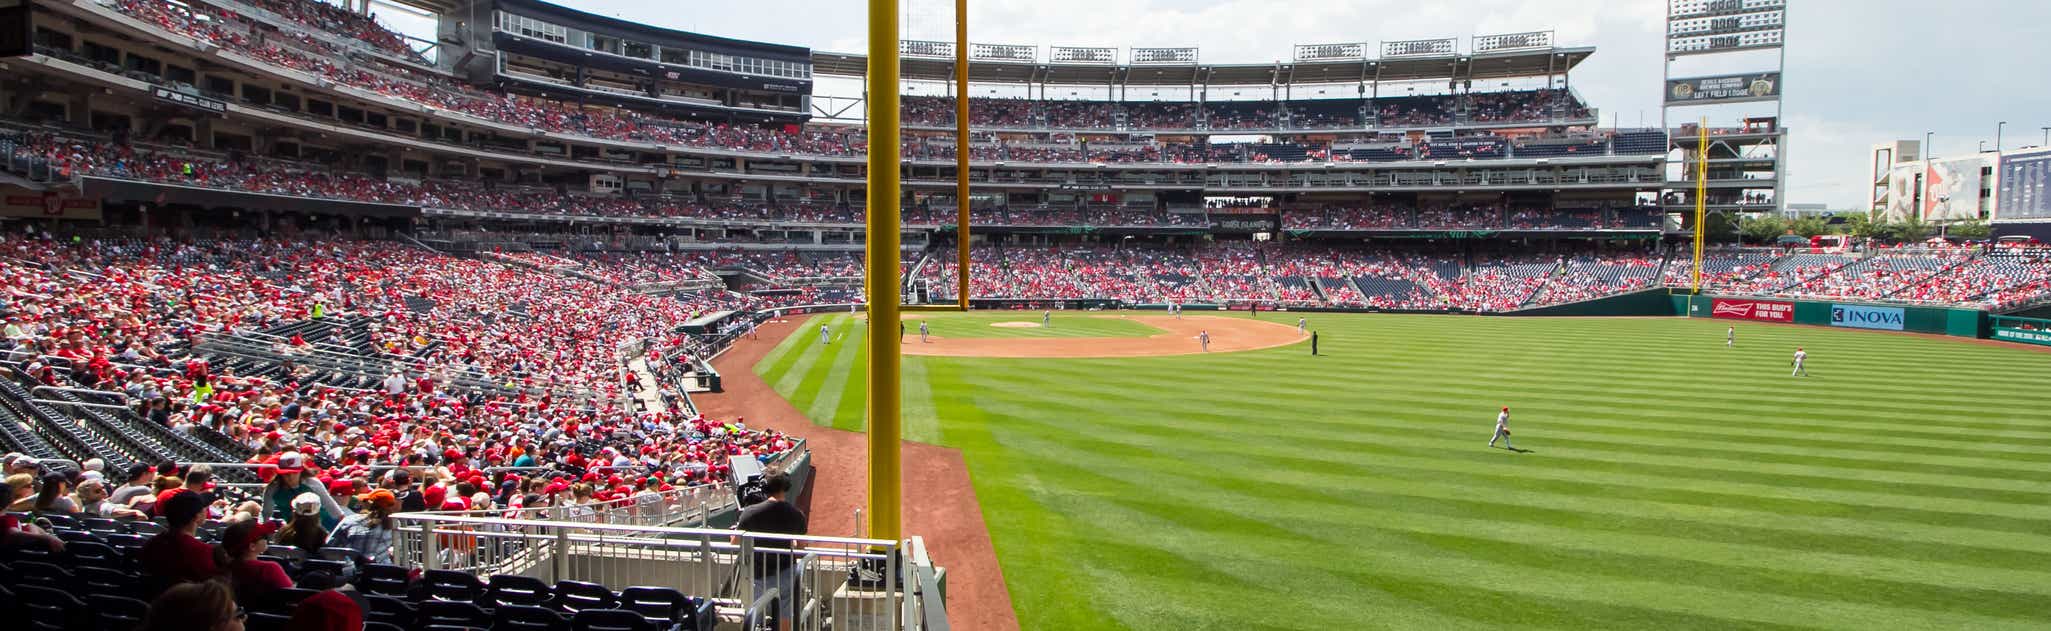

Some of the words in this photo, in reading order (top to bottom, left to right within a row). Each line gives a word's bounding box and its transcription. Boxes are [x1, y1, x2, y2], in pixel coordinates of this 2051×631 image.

[1694, 91, 1710, 99] LEFT
[1710, 89, 1727, 97] FIELD
[1772, 304, 1792, 312] BUD'S
[1755, 310, 1768, 318] FOR
[1769, 311, 1784, 319] YOU.
[1849, 310, 1902, 324] INOVA
